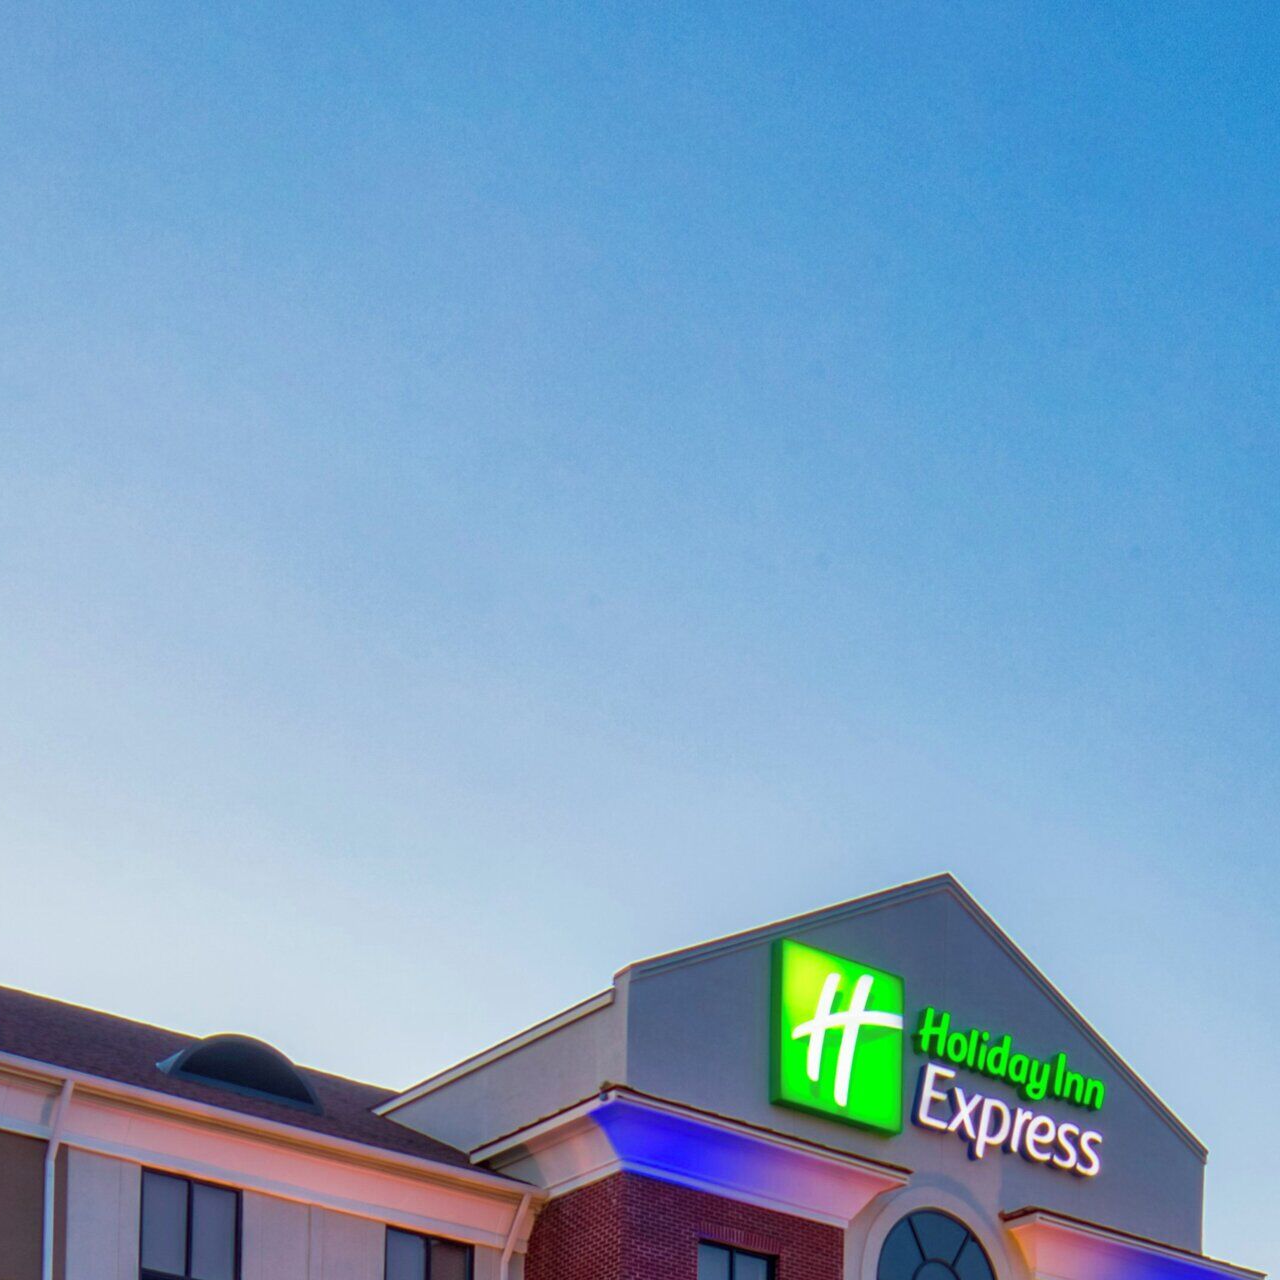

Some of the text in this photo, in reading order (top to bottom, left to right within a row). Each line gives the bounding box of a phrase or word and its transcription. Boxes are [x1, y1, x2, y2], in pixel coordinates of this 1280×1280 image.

[919, 1006, 1105, 1110] Holiday Inn
[918, 1061, 1103, 1177] Express
